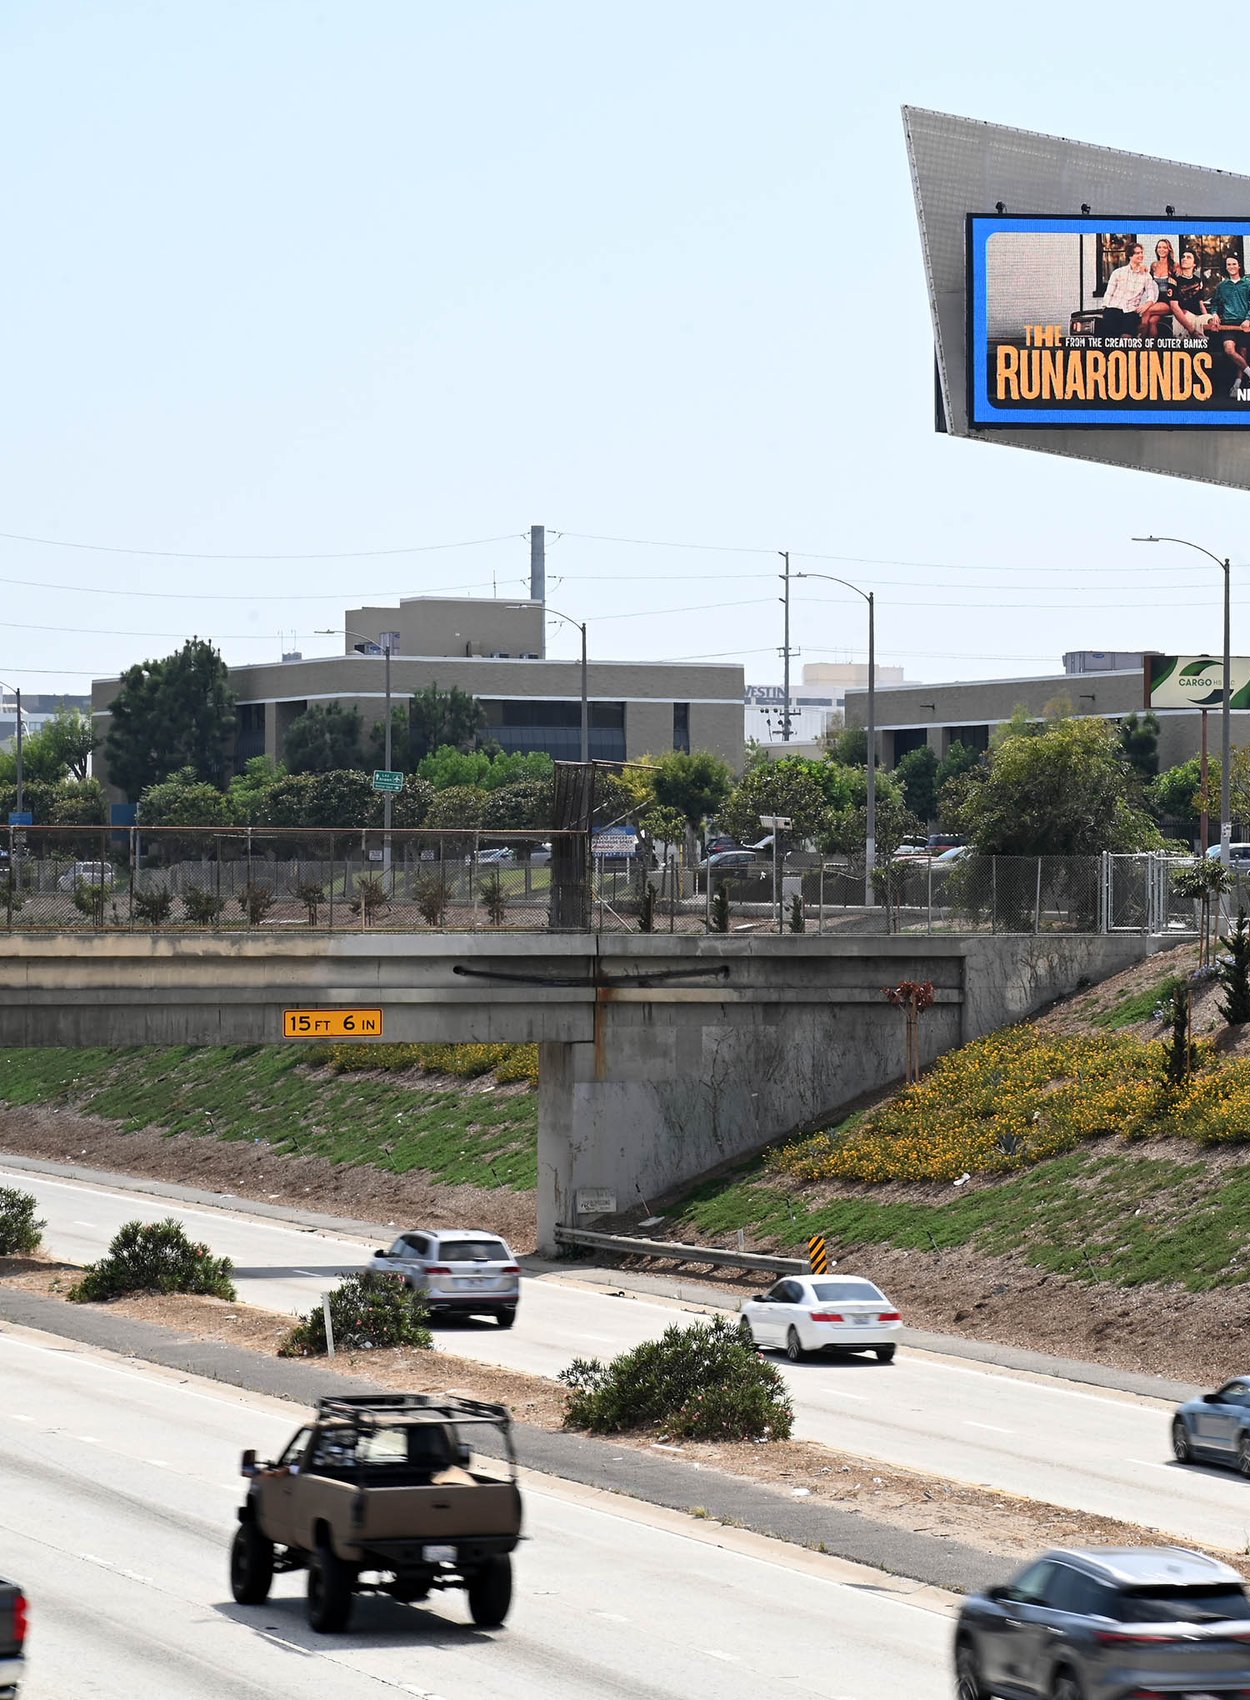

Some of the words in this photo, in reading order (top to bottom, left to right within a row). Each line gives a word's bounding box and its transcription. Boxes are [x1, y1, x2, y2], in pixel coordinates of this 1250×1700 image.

[1024, 325, 1062, 347] THE
[1065, 337, 1086, 348] FROM
[1088, 338, 1102, 348] THE
[1105, 338, 1143, 349] CREATORS
[1145, 338, 1155, 349] OF
[1157, 338, 1181, 349] OUTER
[1183, 338, 1209, 349] BANKS
[996, 345, 1213, 402] RUNAROUNDS
[1178, 678, 1213, 687] CARGO
[290, 1016, 311, 1031] 15
[315, 1020, 331, 1031] FT
[343, 1015, 355, 1031] 6
[362, 1019, 375, 1031] IN
